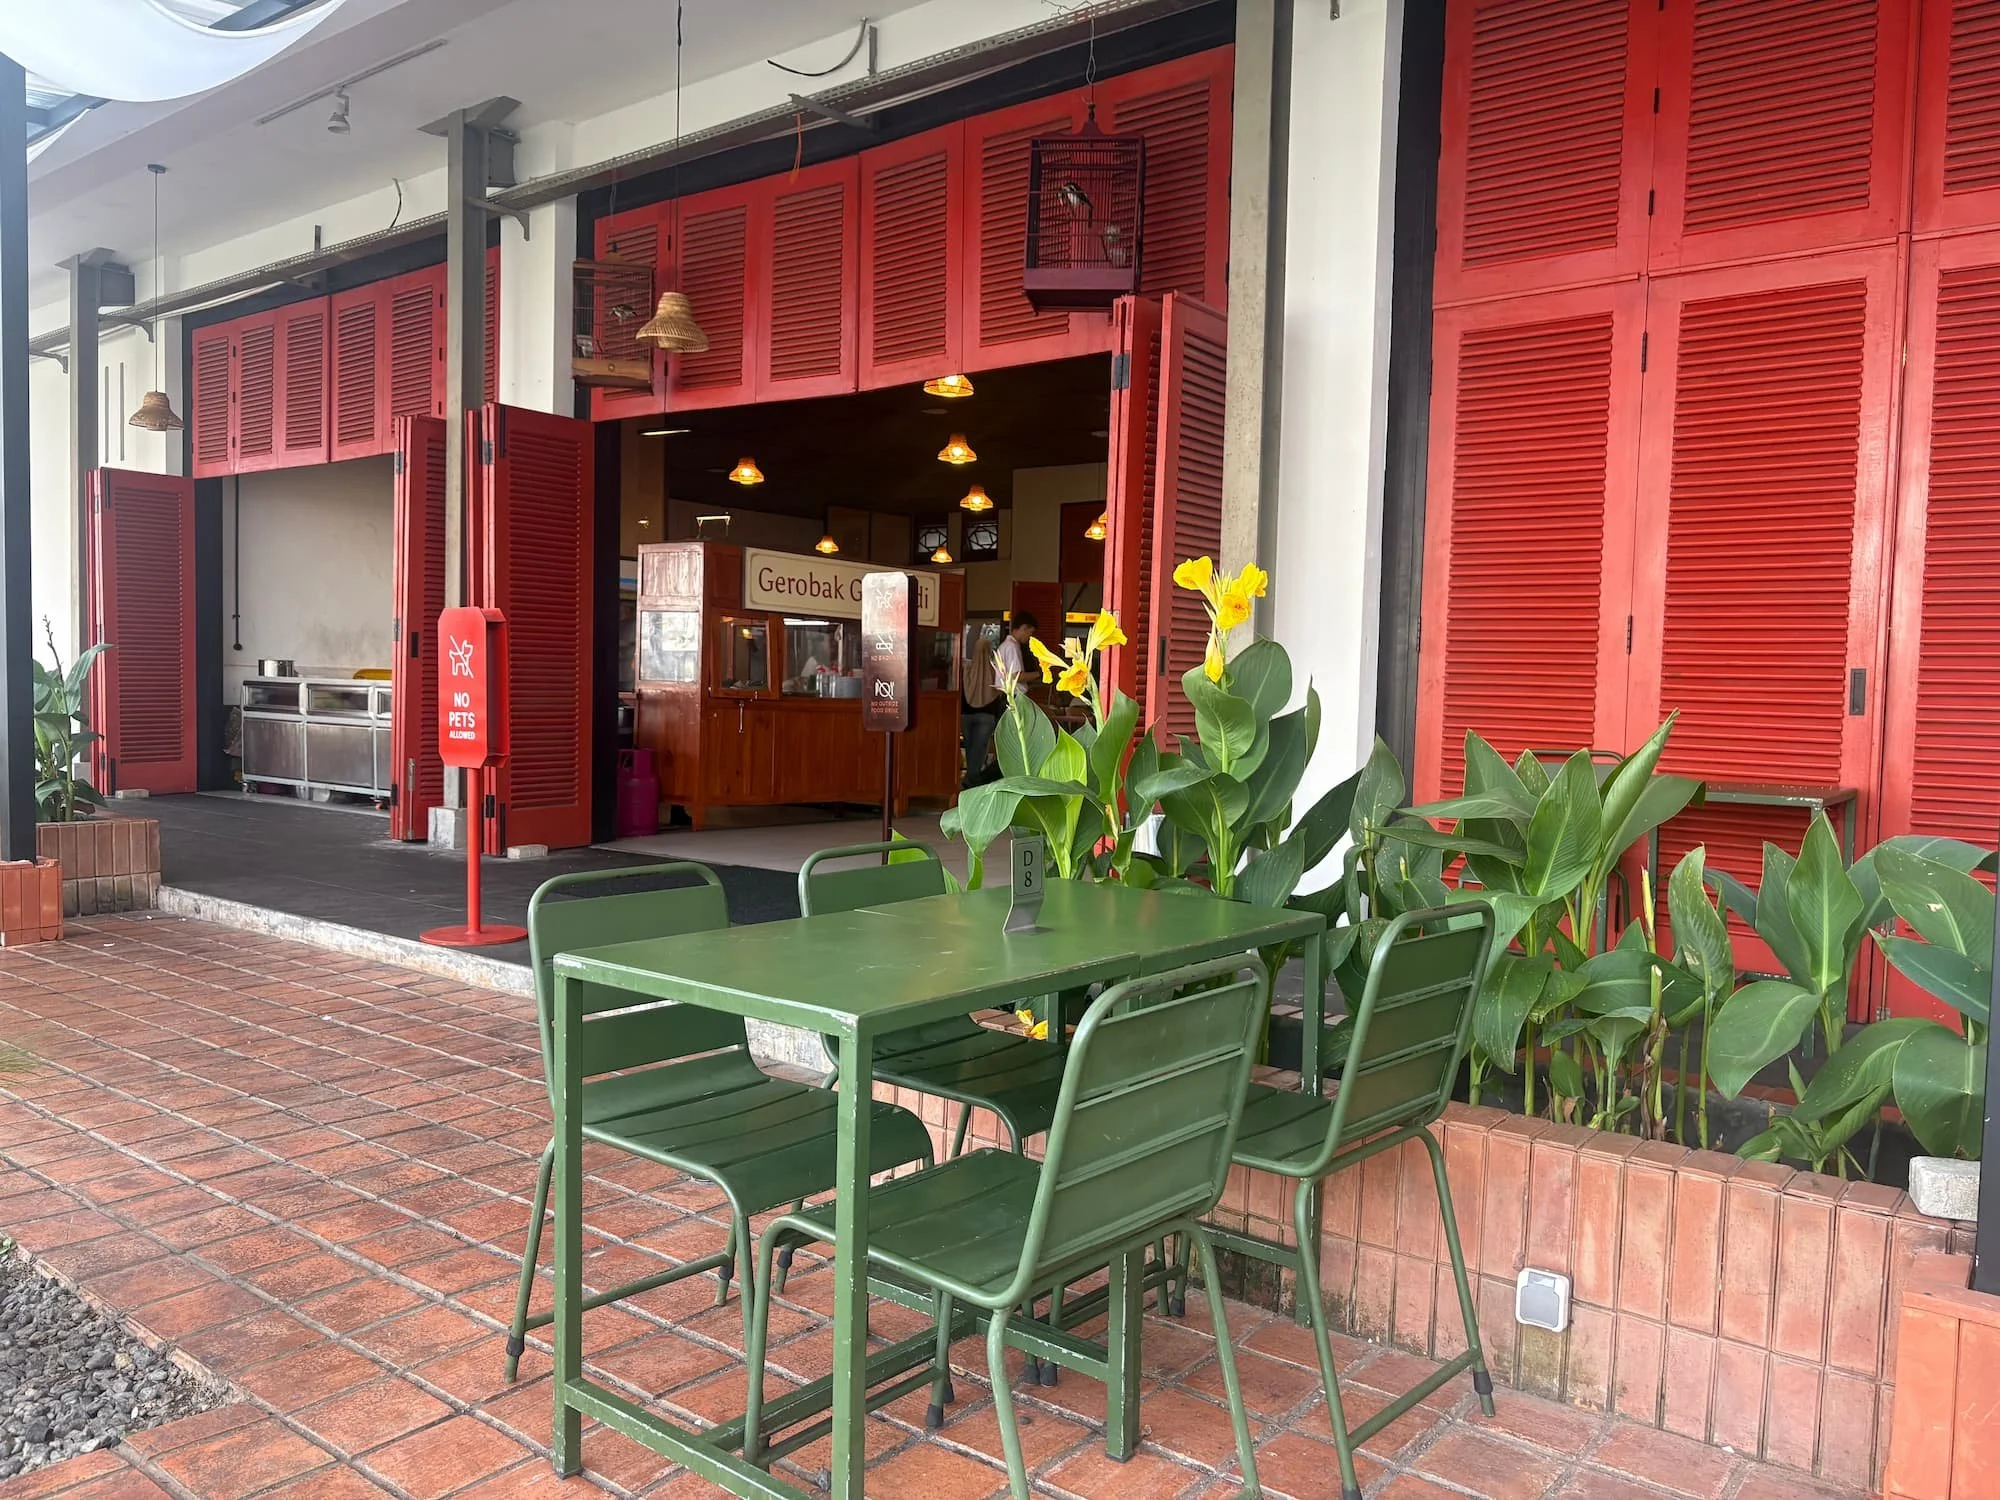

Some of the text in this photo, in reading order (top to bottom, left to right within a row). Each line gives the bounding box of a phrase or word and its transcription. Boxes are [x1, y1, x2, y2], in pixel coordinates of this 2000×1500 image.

[758, 567, 845, 600] Gerobak
[454, 692, 470, 707] NO
[448, 711, 475, 728] PETS
[448, 730, 476, 740] ALLOWED
[1023, 850, 1033, 866] D
[1024, 871, 1032, 887] 8
